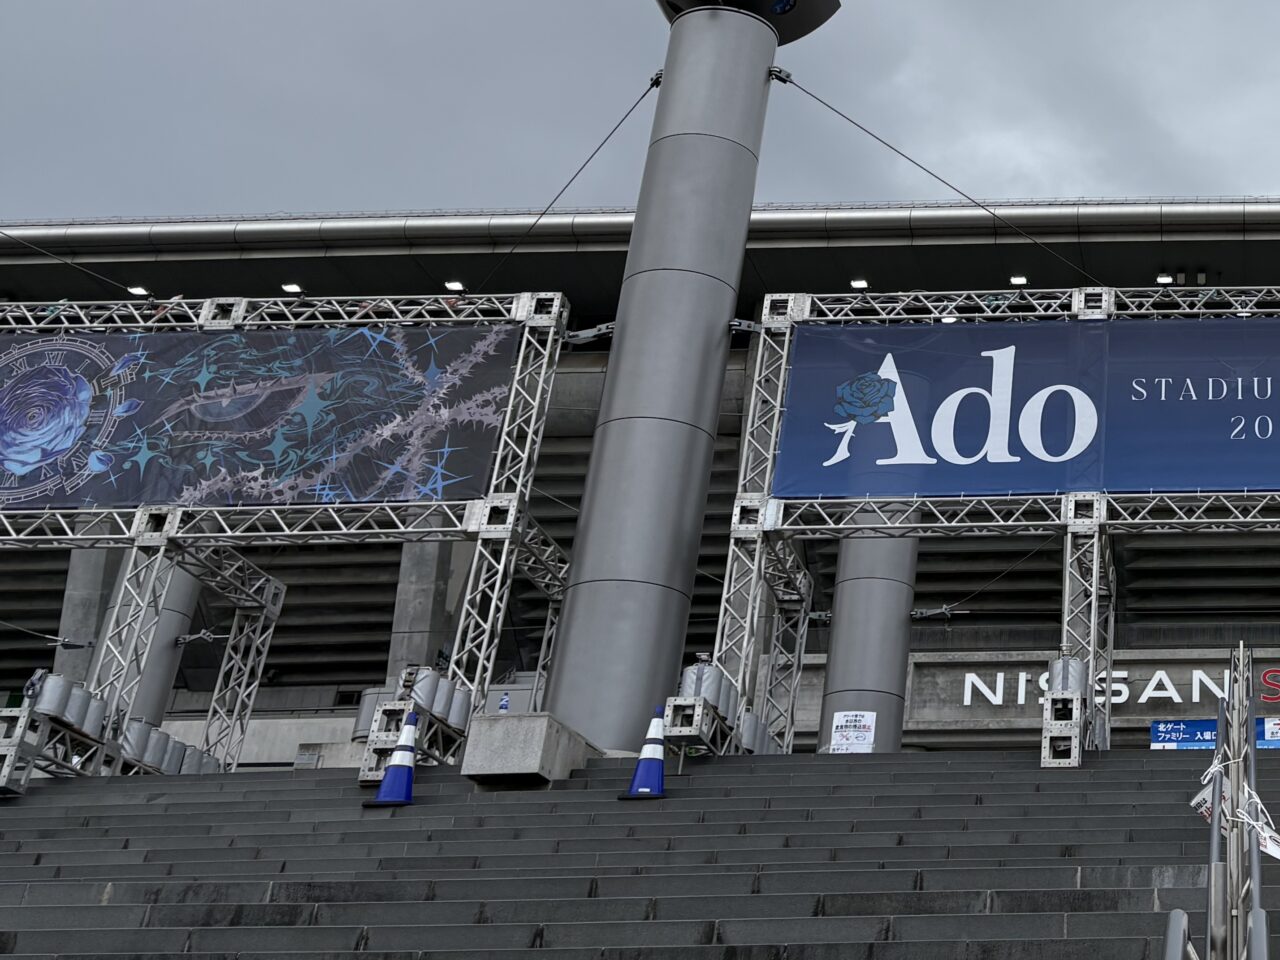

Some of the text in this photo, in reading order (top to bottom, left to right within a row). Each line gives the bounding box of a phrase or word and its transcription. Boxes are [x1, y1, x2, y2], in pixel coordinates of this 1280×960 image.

[823, 345, 1099, 466] Ado
[963, 669, 1230, 706] NISAN
[1157, 722, 1187, 732] 北ゲート
[1157, 732, 1190, 741] ファミリー
